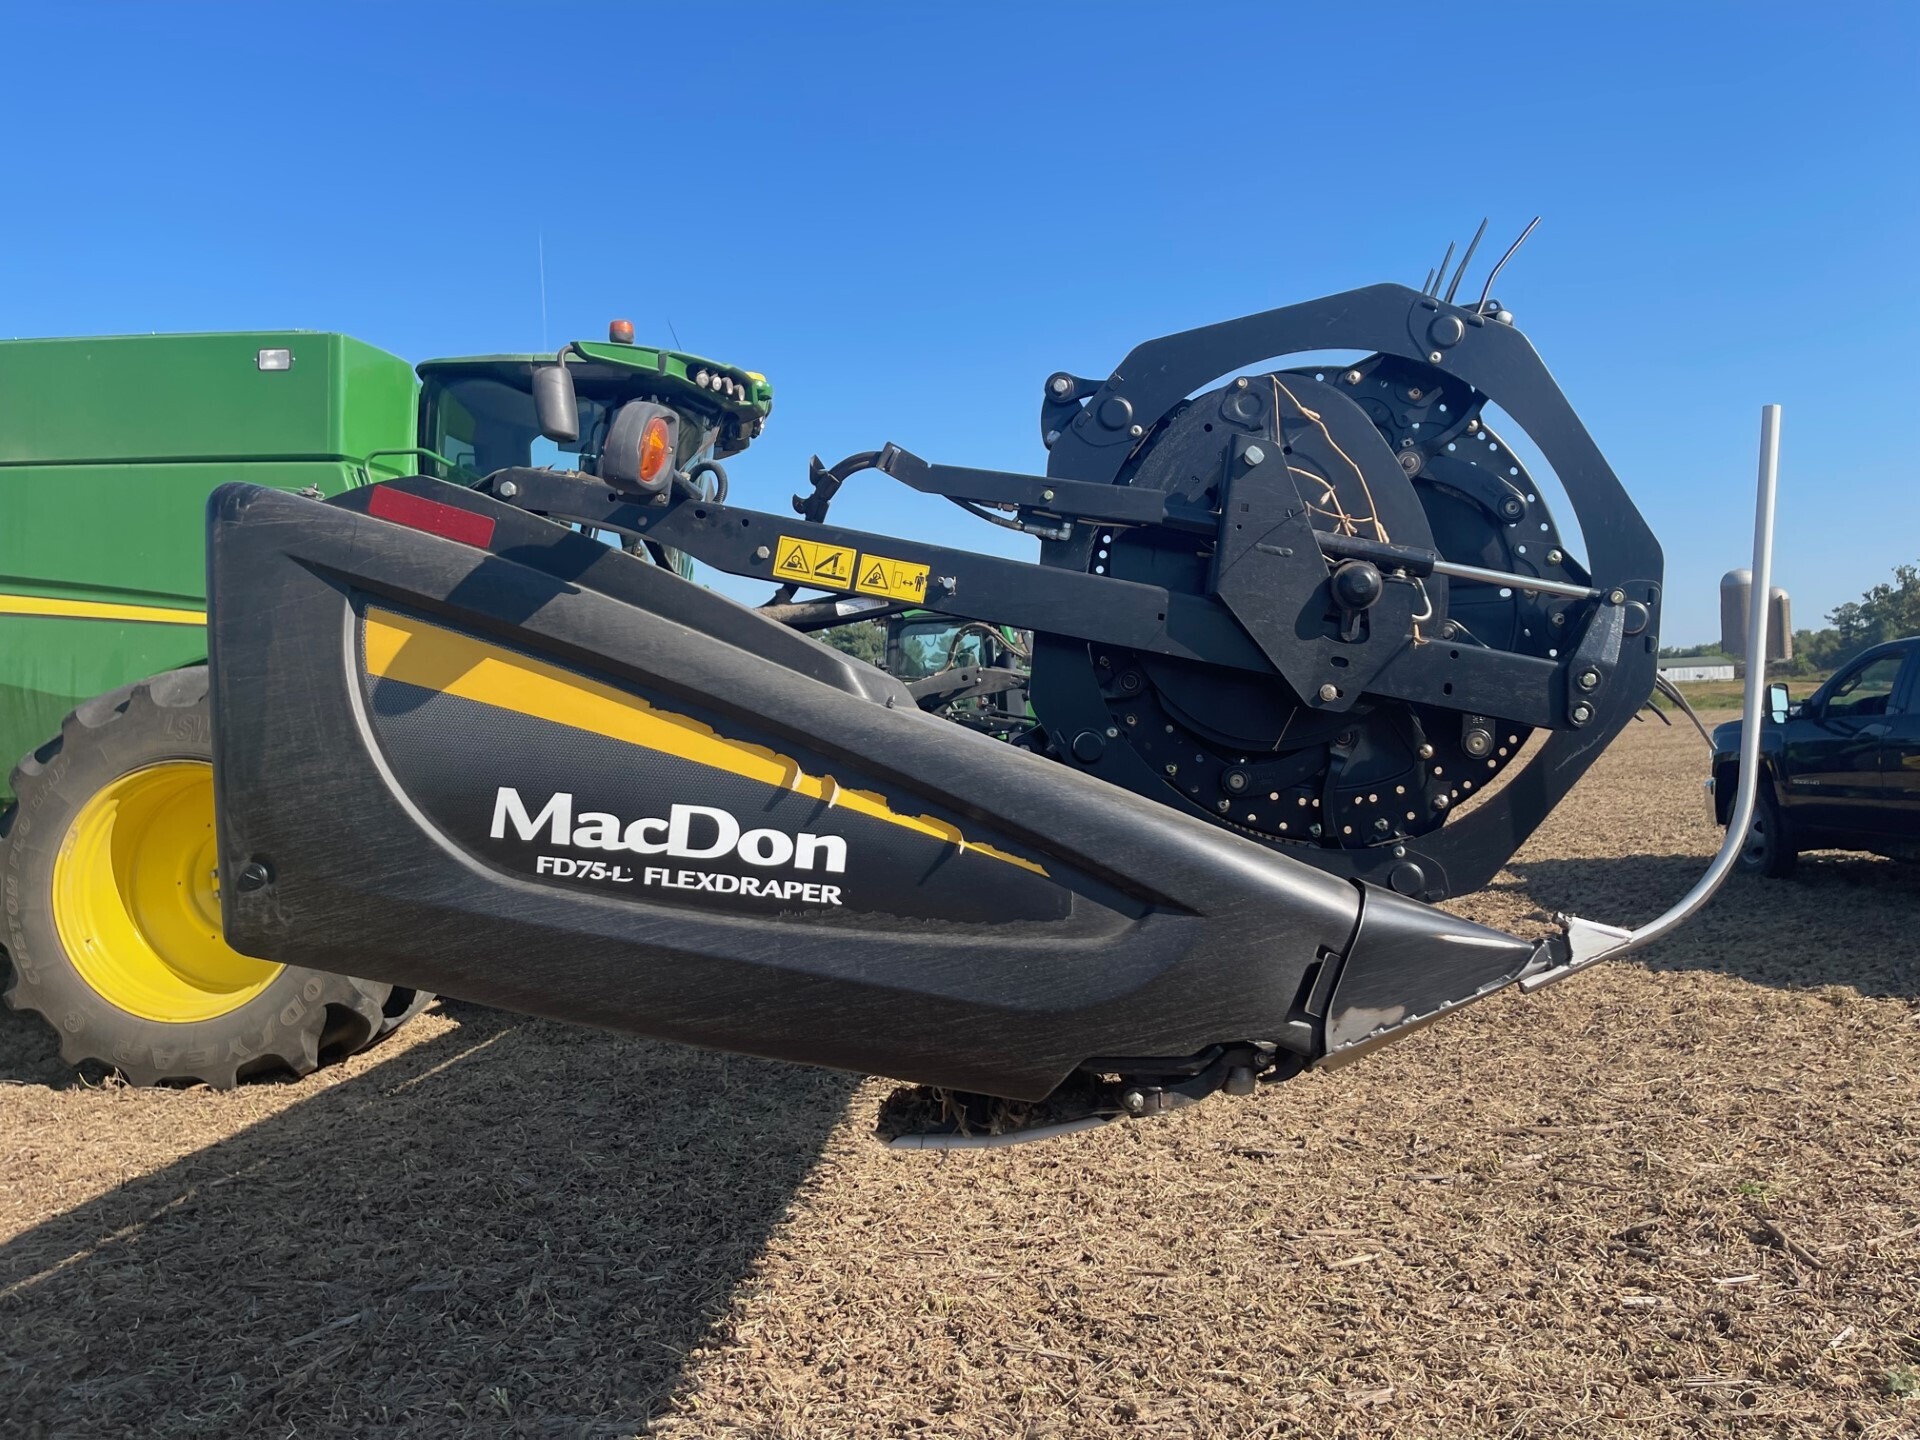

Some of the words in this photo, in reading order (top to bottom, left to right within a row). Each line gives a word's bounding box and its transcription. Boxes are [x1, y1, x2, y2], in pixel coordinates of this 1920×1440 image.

[490, 786, 847, 873] MacDon
[6, 874, 41, 985] CUSTOM
[644, 867, 842, 905] FLEXDRAPER
